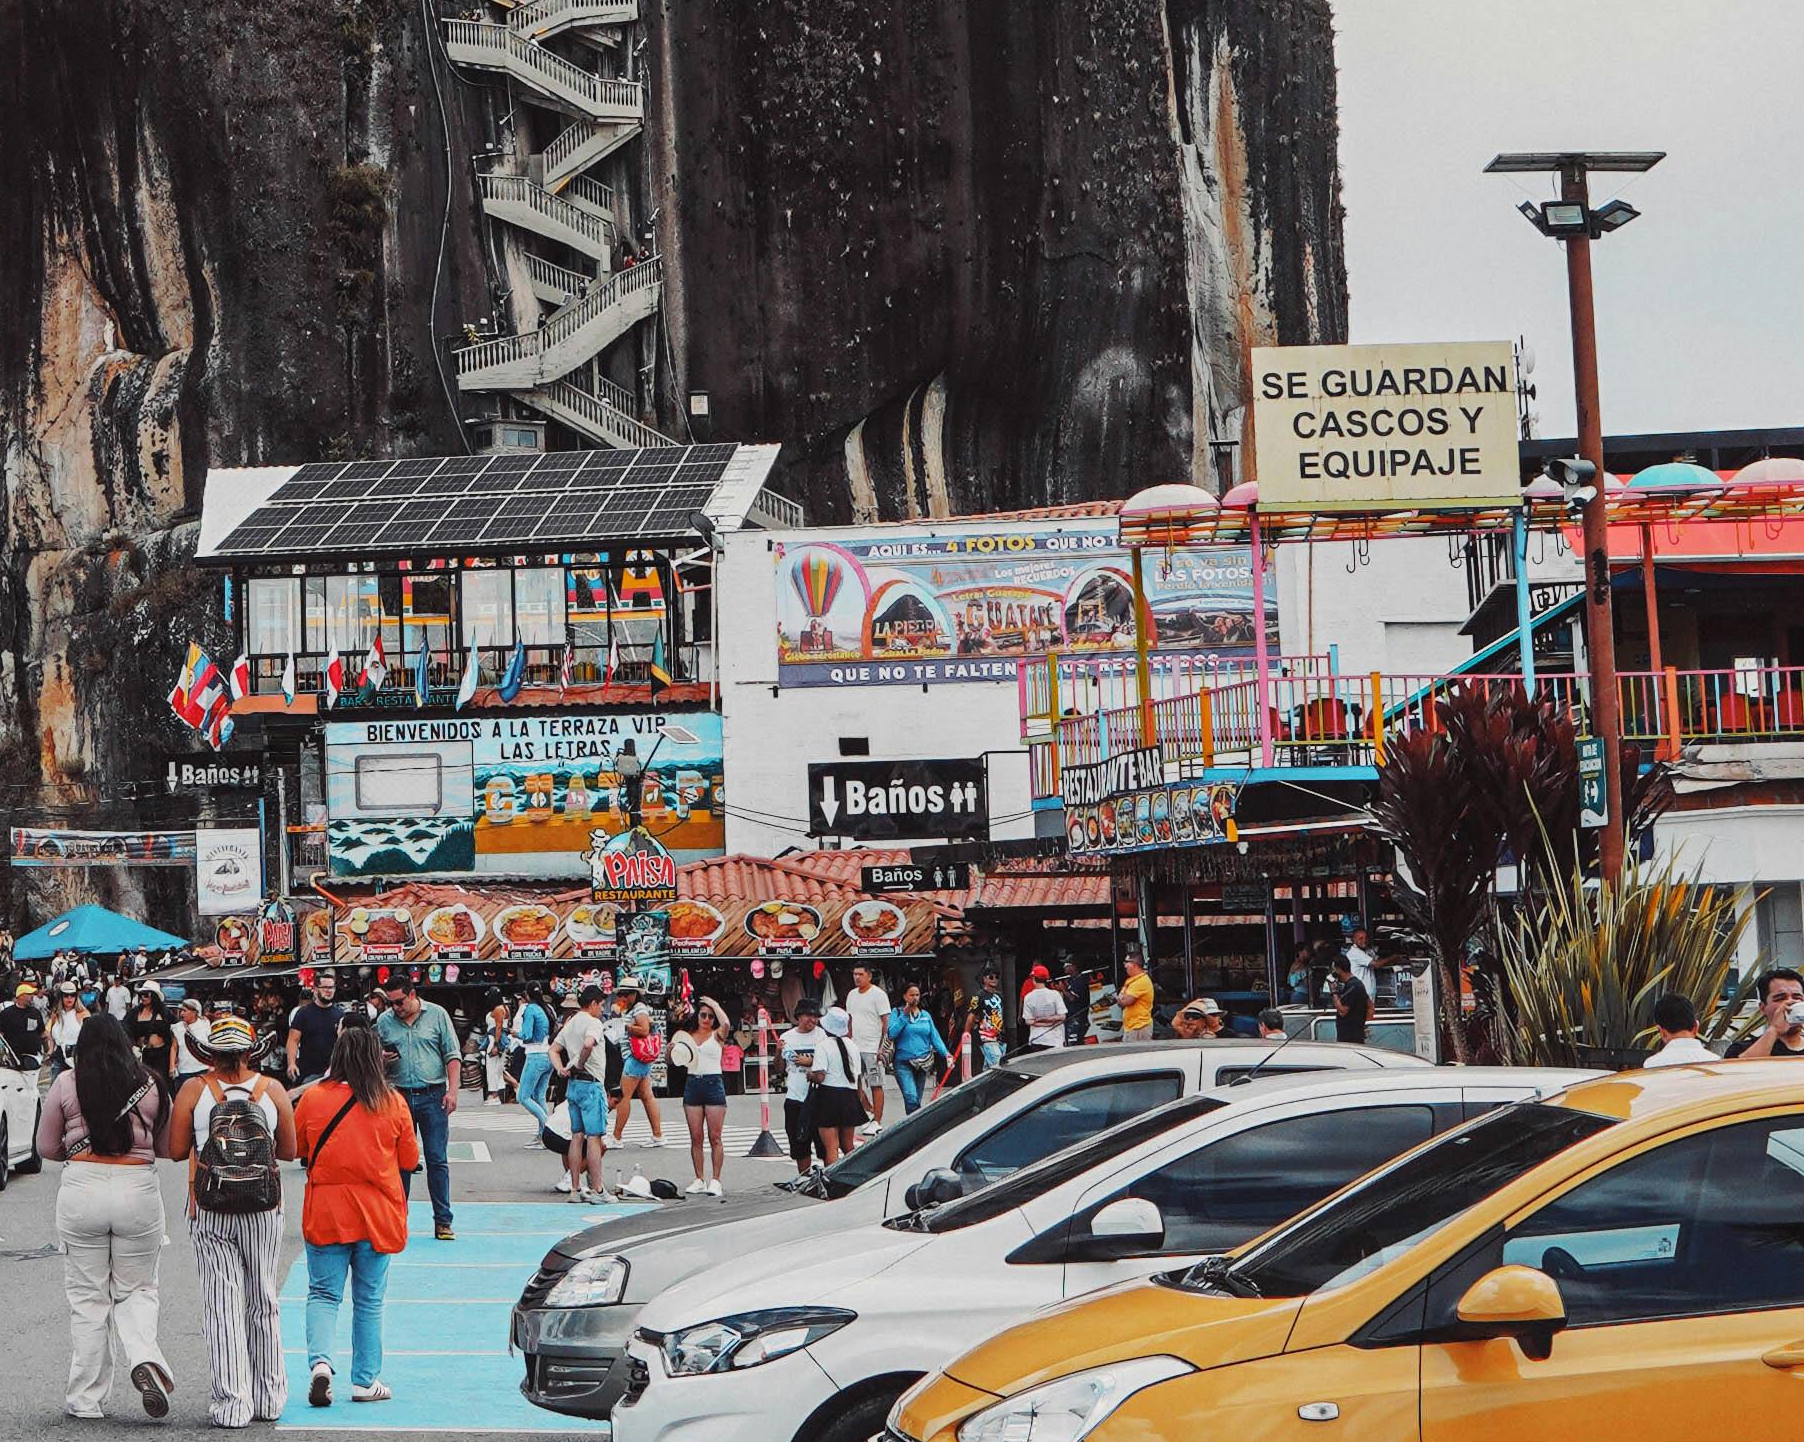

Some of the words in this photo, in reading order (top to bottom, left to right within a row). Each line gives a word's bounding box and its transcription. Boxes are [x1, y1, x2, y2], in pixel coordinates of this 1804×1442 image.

[1262, 372, 1308, 399] SE
[1321, 366, 1507, 397] GUARDAN
[1293, 407, 1449, 438] CASCOS
[1460, 406, 1484, 433] Y
[1299, 448, 1482, 479] EQUIPAJE
[946, 541, 958, 553] 4
[966, 533, 1035, 553] FOTOS
[1046, 537, 1077, 550] QUE
[1081, 536, 1106, 548] NO
[1154, 569, 1187, 583] LAS
[830, 667, 870, 683] QUE
[879, 666, 906, 681] NO
[914, 665, 936, 679] TE
[945, 662, 1018, 678] FALTEN
[368, 721, 481, 742] BIENVENIDOS
[492, 723, 502, 738] A
[509, 721, 529, 737] LA
[539, 718, 620, 736] TERRAZA
[632, 716, 667, 734] VIP
[501, 742, 534, 760] LAS
[545, 739, 612, 760] LETRAS
[181, 763, 240, 785] Baños
[845, 778, 945, 815] Baños
[603, 849, 676, 890] PAISA
[872, 868, 923, 883] Baños
[594, 889, 676, 902] RESTAURANTE
